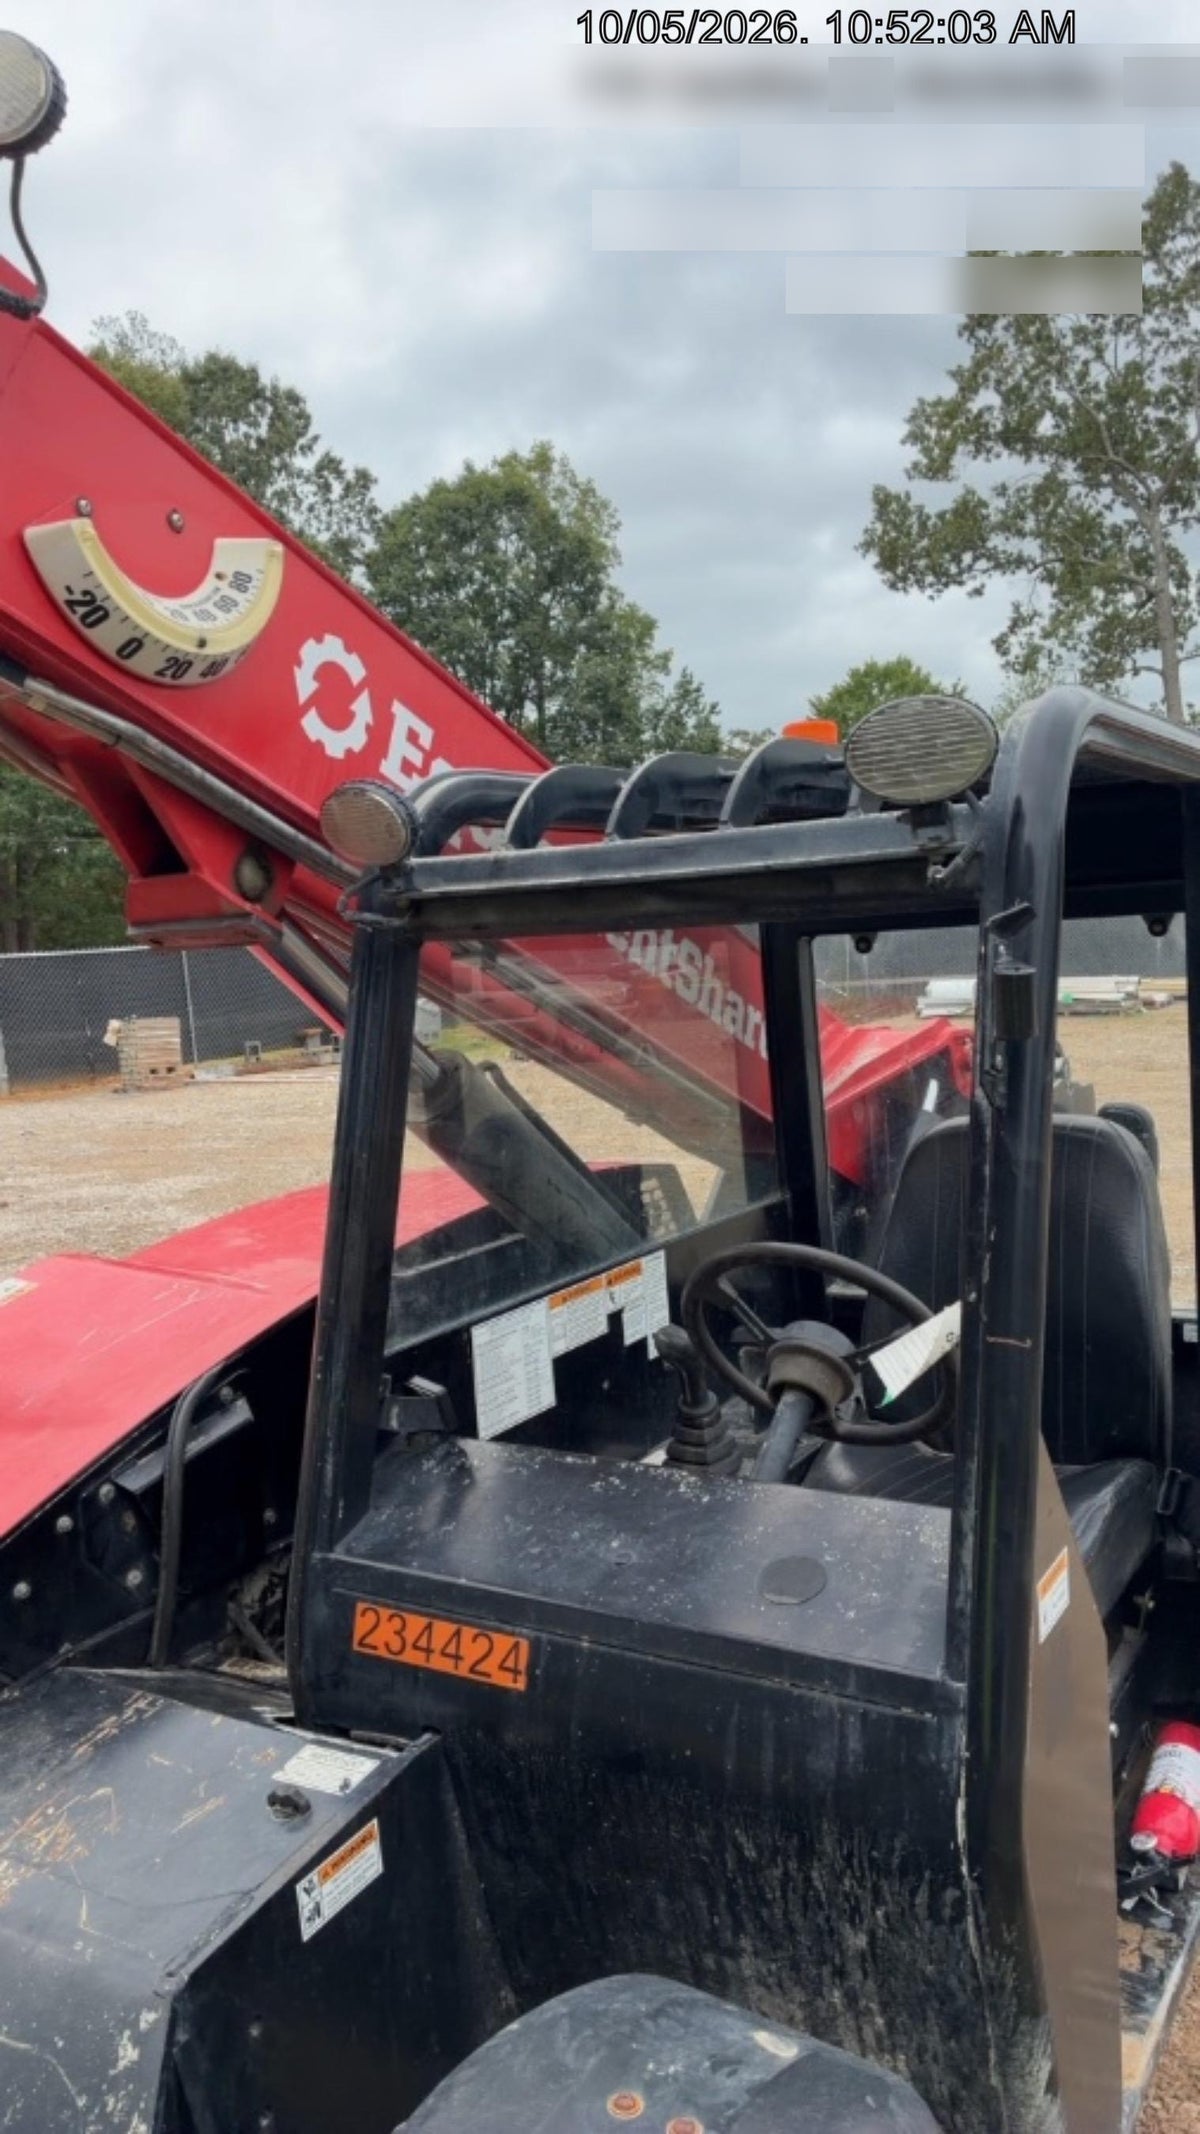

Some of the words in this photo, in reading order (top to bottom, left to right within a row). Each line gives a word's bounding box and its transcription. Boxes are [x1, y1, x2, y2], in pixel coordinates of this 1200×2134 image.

[228, 570, 252, 593] 80
[64, 584, 110, 630] -20
[116, 637, 144, 660] 0
[153, 655, 194, 679] 20
[357, 1606, 523, 1684] 234424
